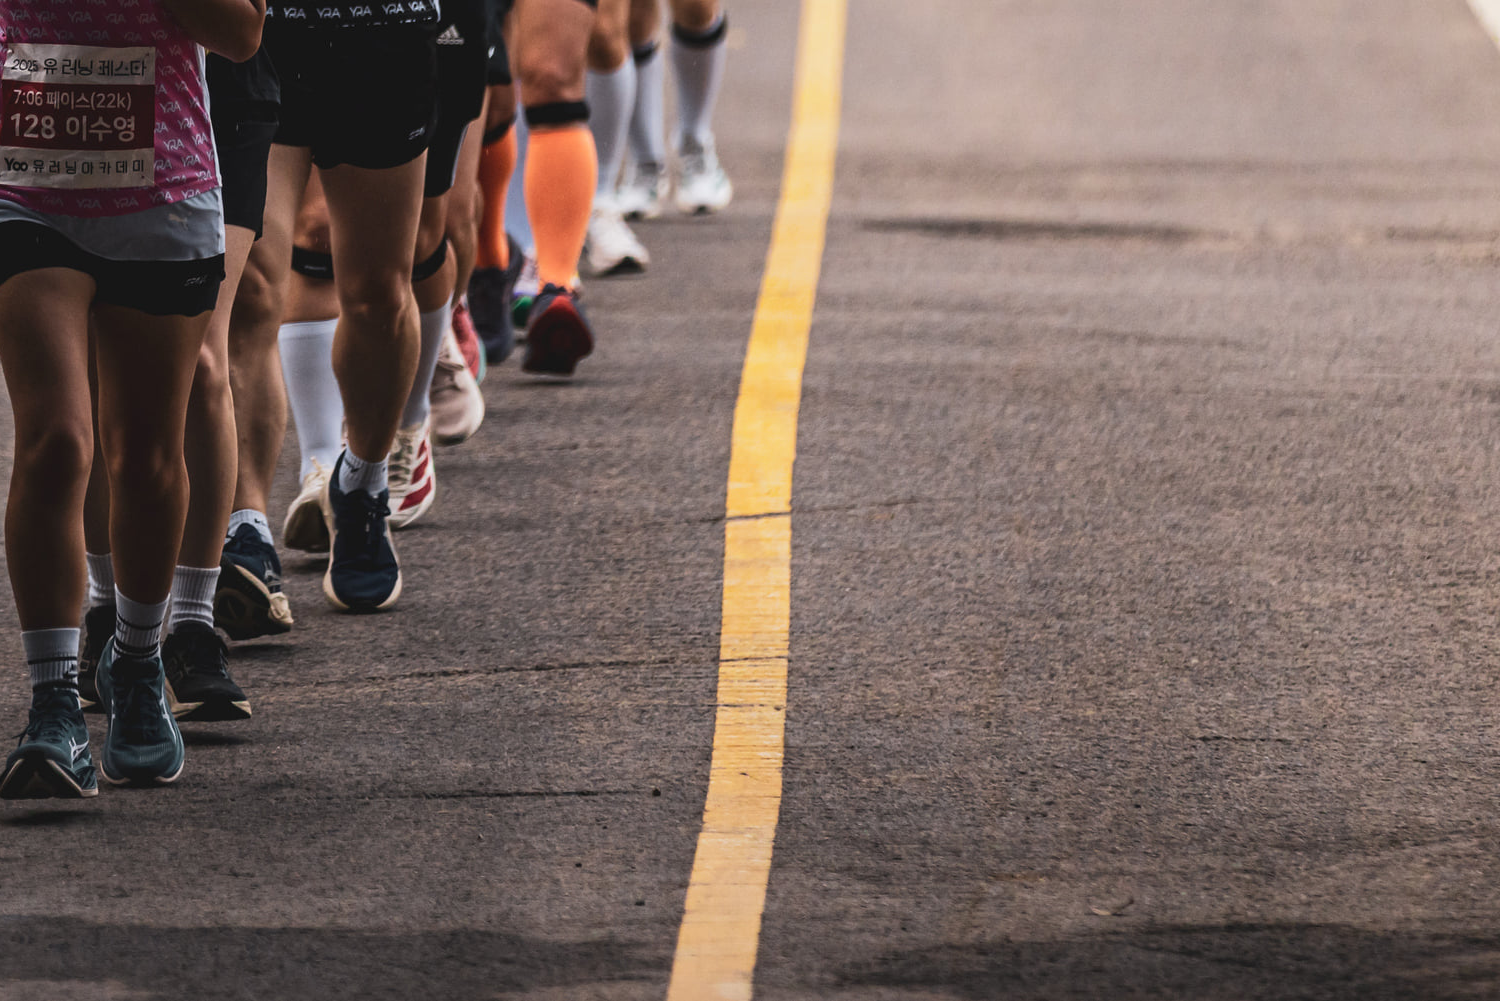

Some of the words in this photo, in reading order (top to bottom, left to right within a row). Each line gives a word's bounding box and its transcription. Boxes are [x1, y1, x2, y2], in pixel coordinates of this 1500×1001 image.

[317, 7, 340, 18] YRA
[11, 58, 38, 72] 2025
[98, 59, 147, 77] 페스타
[13, 89, 43, 106] 7:06
[46, 90, 132, 112] 페이스(22k)
[10, 112, 56, 140] 128
[66, 114, 136, 142] 이수영
[164, 139, 184, 150] YRA
[4, 157, 28, 172] Yoo
